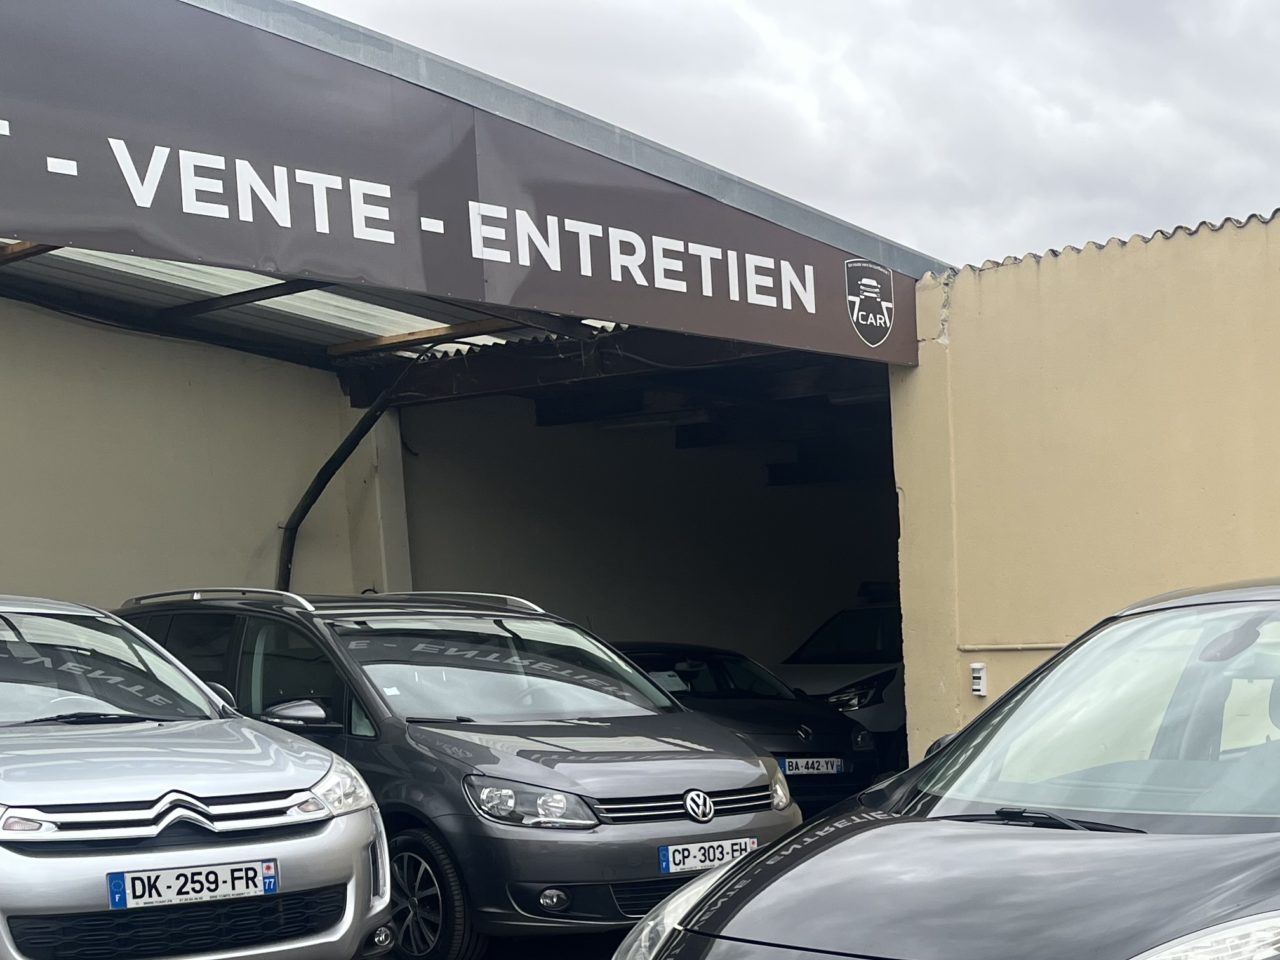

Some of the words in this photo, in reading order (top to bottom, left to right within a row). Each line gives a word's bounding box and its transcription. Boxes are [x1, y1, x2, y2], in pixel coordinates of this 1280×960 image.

[108, 138, 396, 245] VENTE
[468, 201, 816, 314] ENTRETIEN
[672, 841, 748, 866] CP-303-EH
[131, 867, 258, 900] DK-259-FR
[264, 878, 275, 890] 77
